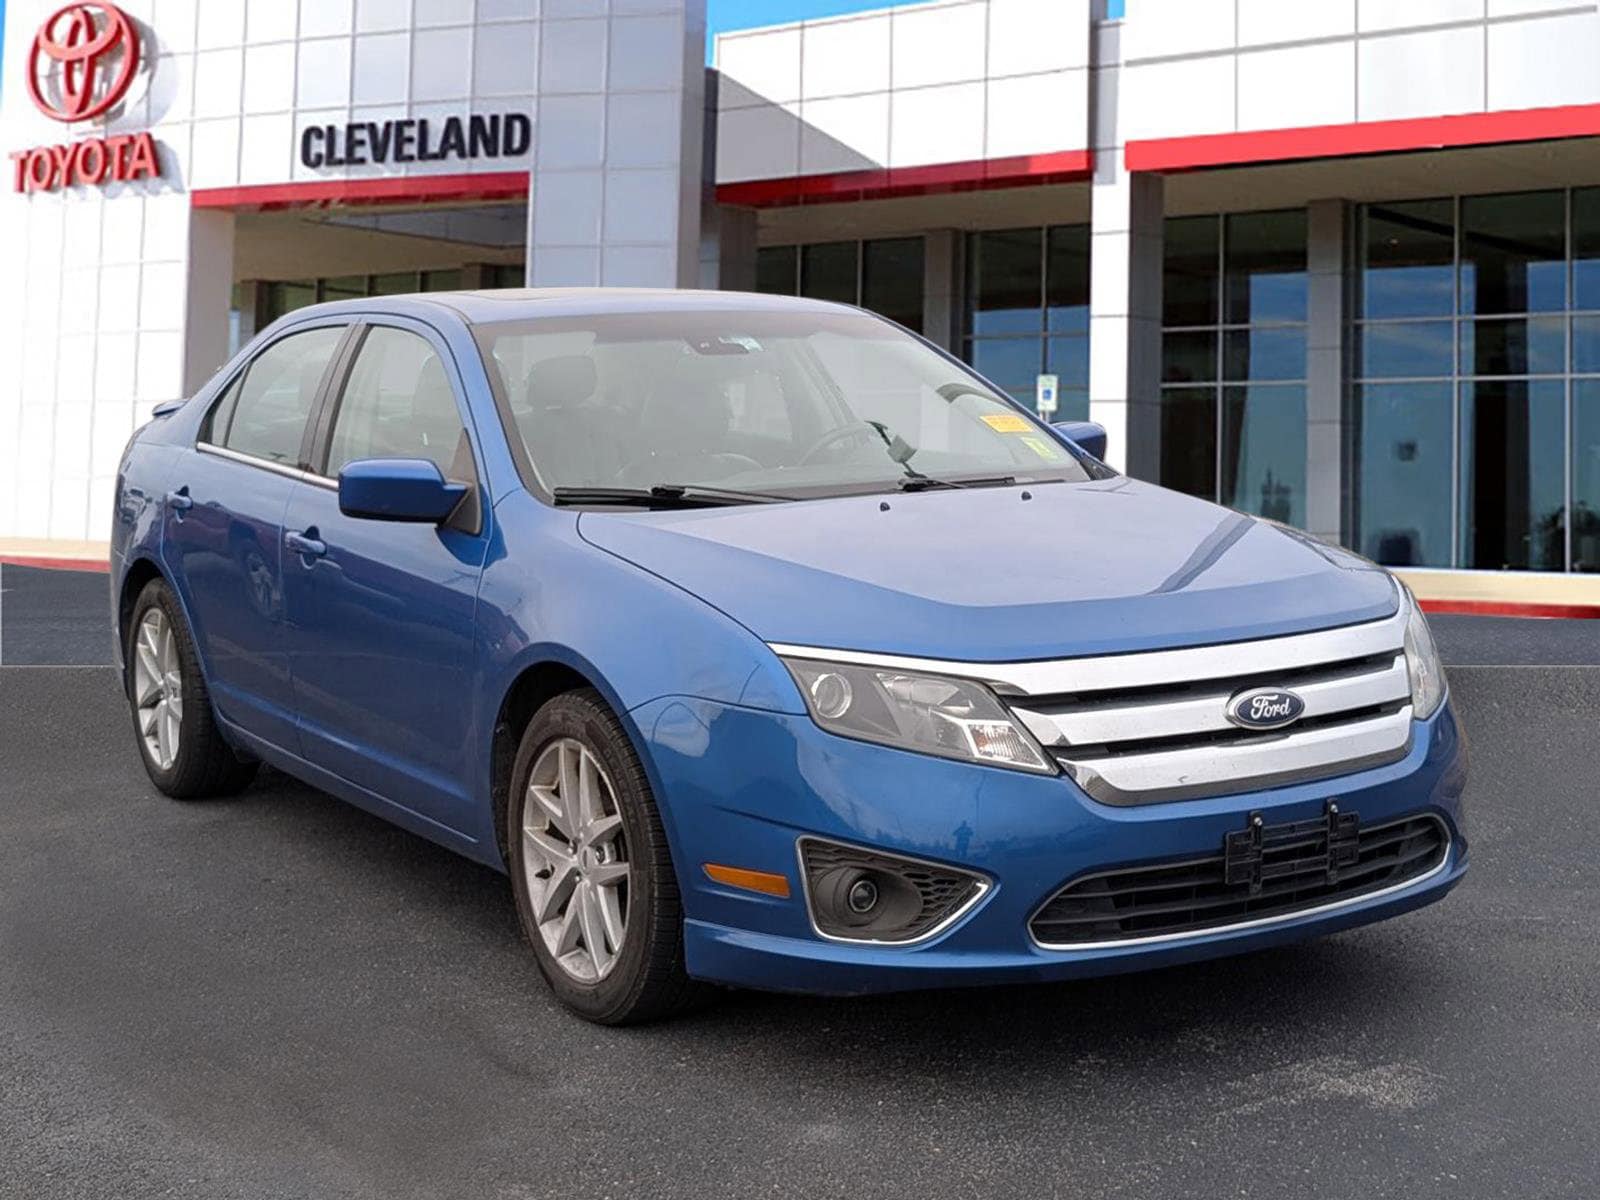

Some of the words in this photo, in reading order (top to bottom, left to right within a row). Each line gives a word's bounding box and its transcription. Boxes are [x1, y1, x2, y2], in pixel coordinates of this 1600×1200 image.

[8, 131, 161, 193] TOYOTA
[301, 113, 531, 168] CLEVELAND
[1250, 694, 1291, 720] Ford
